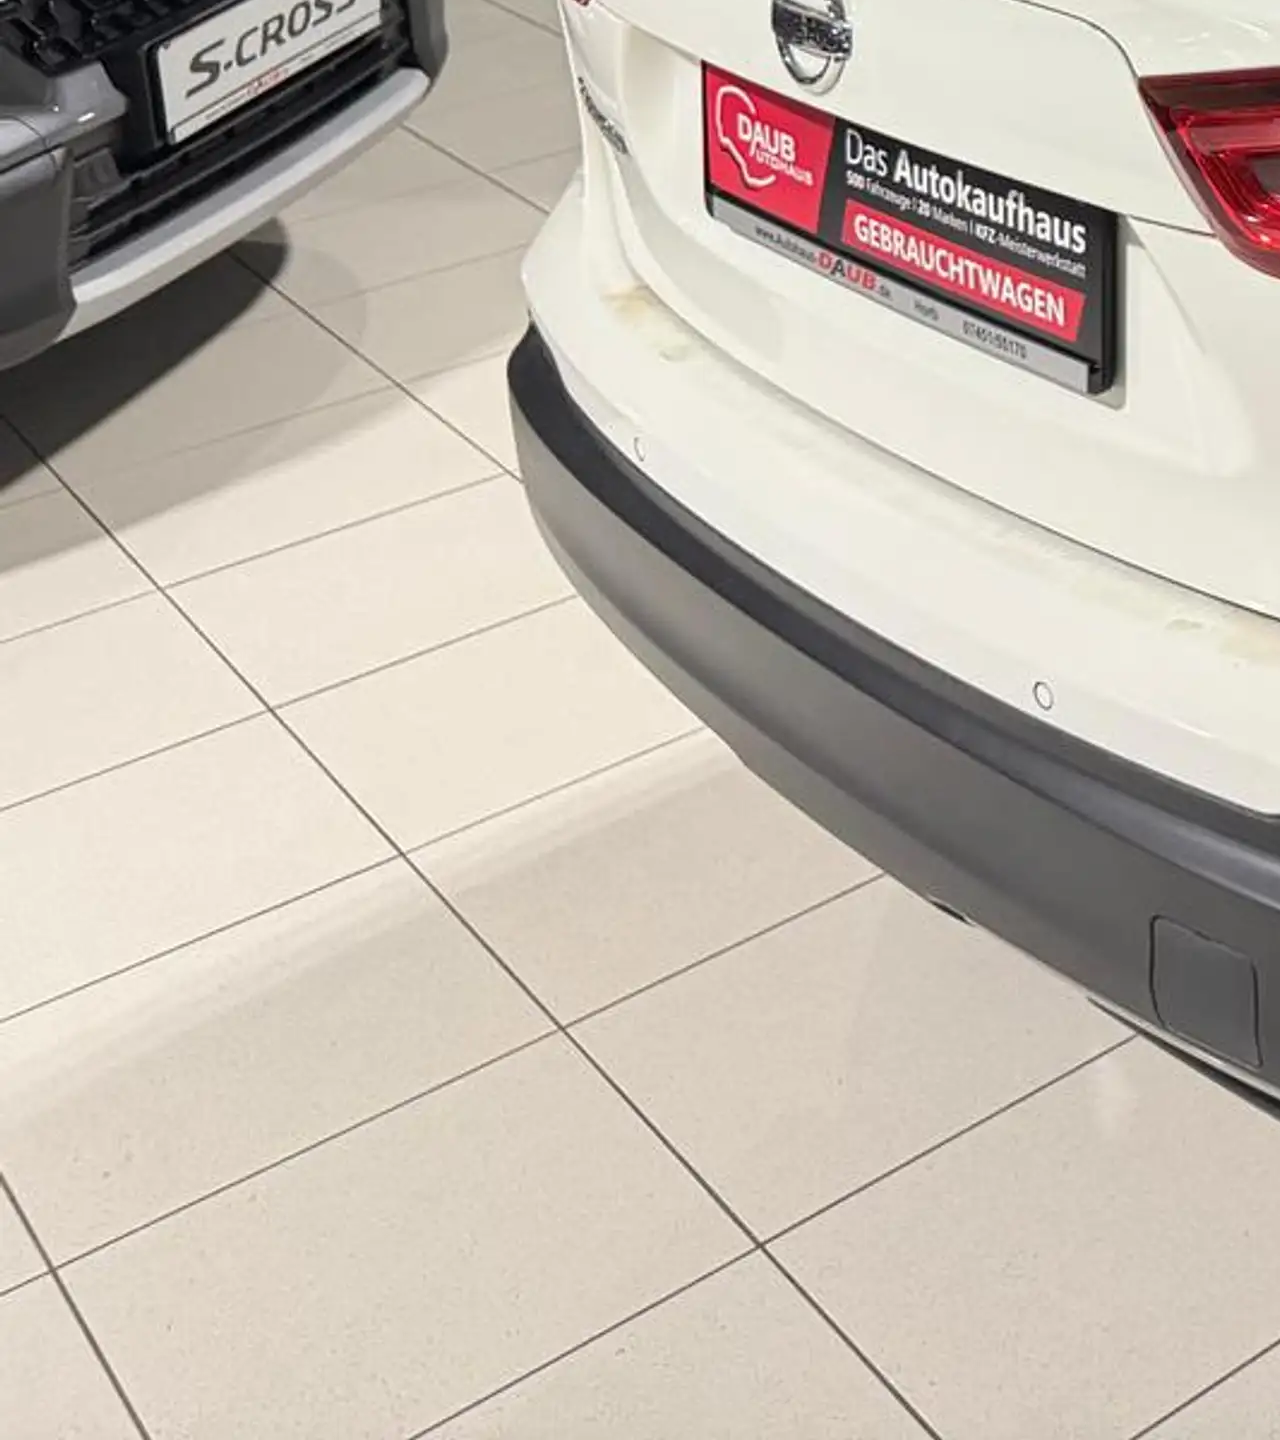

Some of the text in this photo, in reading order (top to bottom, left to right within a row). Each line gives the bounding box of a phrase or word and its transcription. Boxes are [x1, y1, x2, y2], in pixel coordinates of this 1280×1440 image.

[736, 113, 797, 163] DAUB
[844, 129, 1087, 254] Das Autokaufhaus
[853, 212, 1066, 328] GEBRAUCHTWAGEN
